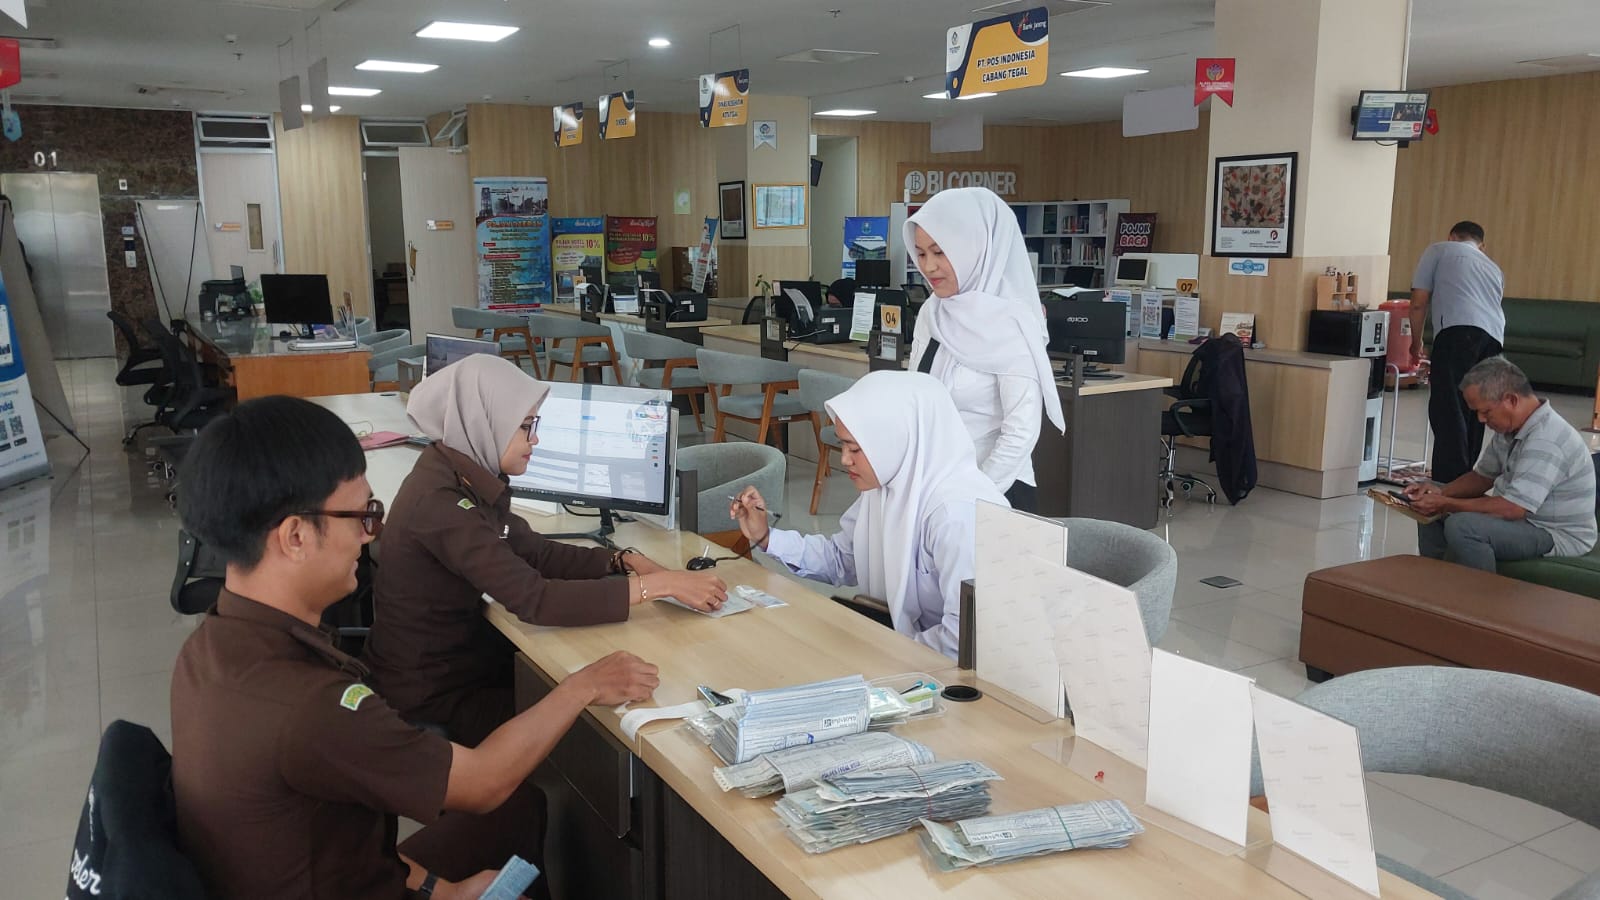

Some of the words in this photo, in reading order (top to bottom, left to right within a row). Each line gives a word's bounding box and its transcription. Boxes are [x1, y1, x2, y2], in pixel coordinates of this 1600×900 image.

[977, 59, 986, 69] PT.
[986, 56, 999, 67] POS
[1000, 49, 1036, 66] INDONESIA
[982, 69, 1007, 83] CABANG
[1008, 66, 1028, 79] TEGAL
[926, 170, 944, 195] BI
[947, 171, 1016, 195] CORNER
[1120, 222, 1150, 235] POJOK
[642, 232, 656, 242] 10%
[1120, 235, 1148, 247] BACA
[586, 239, 600, 249] 10%
[1180, 282, 1193, 292] 07
[885, 311, 897, 325] 04
